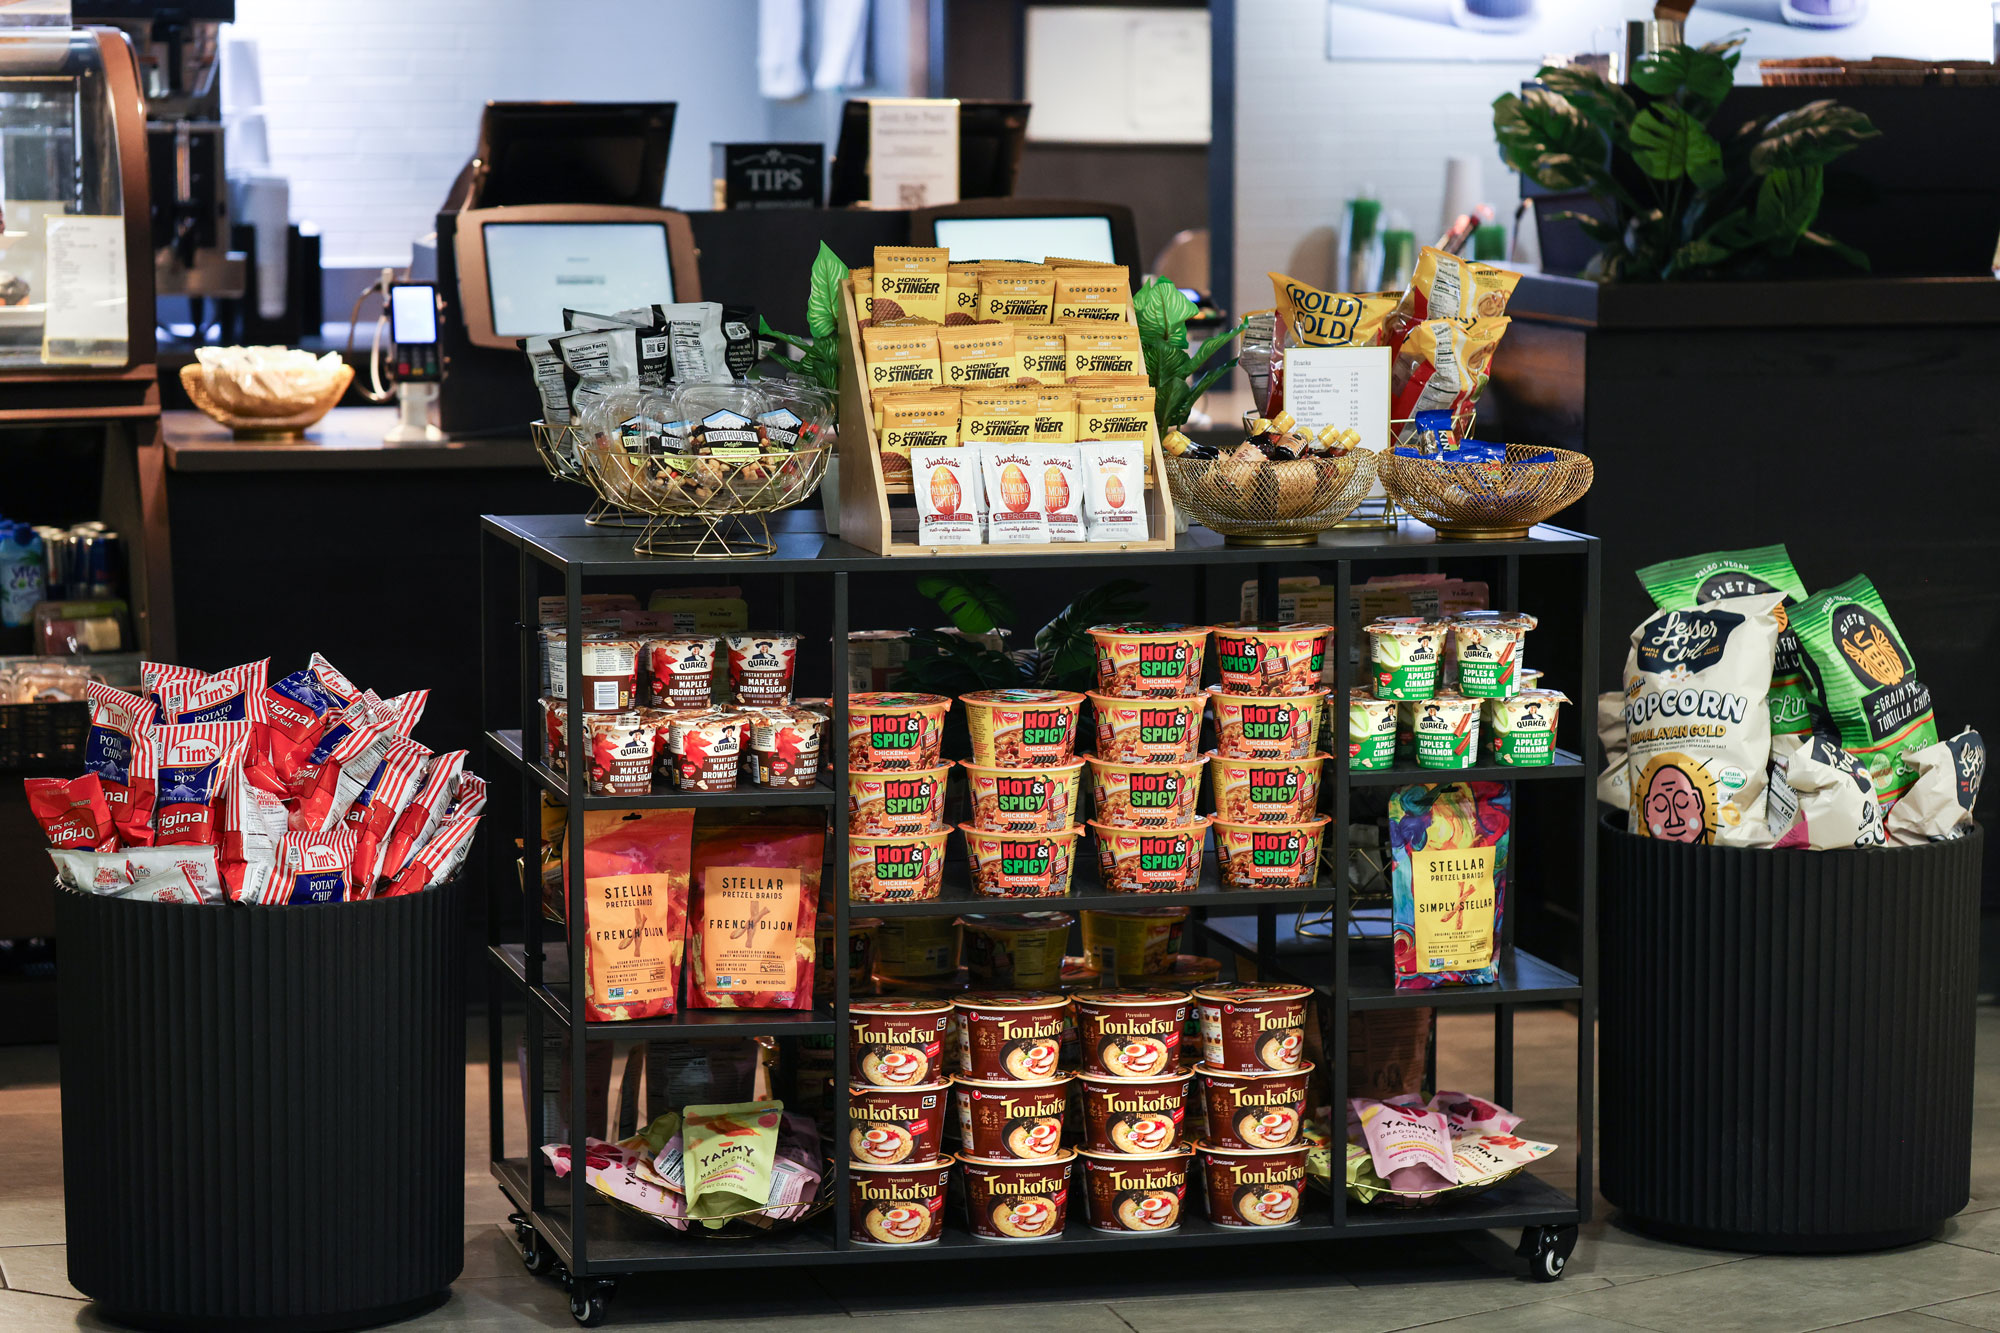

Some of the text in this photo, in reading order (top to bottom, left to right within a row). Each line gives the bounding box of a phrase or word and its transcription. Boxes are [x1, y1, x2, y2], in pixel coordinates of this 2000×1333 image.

[747, 168, 803, 191] TIPS
[894, 282, 940, 294] STINGER
[1002, 304, 1048, 315] STINGER
[1292, 288, 1354, 317] ROLD
[568, 345, 592, 353] Nutrition
[592, 342, 607, 350] Facts
[599, 359, 608, 367] 160
[889, 363, 922, 371] HONEY
[965, 362, 999, 370] HONEY
[1088, 360, 1133, 372] STINGER
[888, 368, 934, 382] STINGER
[964, 366, 1010, 381] STINGER
[983, 424, 1030, 436] STINGER
[1102, 421, 1149, 433] STINGER
[707, 431, 756, 442] NORTHWEST
[924, 456, 961, 469] Justin's
[995, 454, 1031, 467] Justin's
[1098, 455, 1128, 466] Justin's
[1001, 482, 1029, 493] ALMOND
[1002, 492, 1029, 505] BUTTER
[1695, 560, 1749, 579] PALEO VEGAN
[1711, 581, 1756, 600] SIETE
[1652, 611, 1718, 645] Lesser
[1840, 613, 1866, 635] SIETE
[1463, 650, 1493, 659] QUAKER
[1662, 635, 1711, 663] Evil
[748, 659, 780, 668] QUAKER
[1221, 655, 1257, 672] SPICY
[1409, 653, 1435, 663] QUAKER
[679, 661, 708, 671] QUAKER
[1141, 661, 1184, 677] SPICY
[1463, 669, 1488, 677] APPLES
[748, 678, 773, 687] MAPLE
[1223, 672, 1243, 680] CHICKEN
[1407, 672, 1430, 680] APPLES
[1462, 677, 1497, 685] CINNAMON
[679, 680, 702, 689] MAPLE
[739, 685, 787, 693] BROWN SUGAR
[1405, 679, 1435, 688] CINNAMON
[194, 680, 233, 707] Tim's
[669, 686, 712, 696] BROWN SUGAR
[169, 695, 181, 704] 230
[1879, 688, 1906, 712] GRAIN
[194, 704, 232, 723] POTATO
[1625, 688, 1747, 733] POPCORN
[1877, 689, 1931, 733] TORTILLA CHIPS
[105, 706, 129, 733] Tim's
[277, 717, 293, 729] Salt
[1516, 719, 1547, 729] QUAKER
[1024, 728, 1066, 745] SPICY
[1142, 727, 1185, 743] SPICY
[1244, 723, 1289, 739] SPICY
[1630, 724, 1726, 746] HIMALAYAN GOLD
[872, 732, 919, 748] SPICY
[1142, 743, 1171, 751] CHICKEN
[1245, 739, 1273, 747] CHICKEN
[176, 745, 216, 763] Tim's
[1131, 791, 1176, 807] SPICY
[1251, 786, 1297, 802] SPICY
[1780, 805, 1793, 820] 120
[162, 825, 190, 837] Sea Salt
[308, 850, 337, 868] Tim's
[1429, 858, 1485, 873] STELLAR
[722, 877, 784, 891] STELLAR
[1430, 871, 1485, 883] PRETZEL BRAIDS
[604, 884, 653, 899] STELLAR
[722, 891, 783, 900] PRETZEL BRAIDS
[605, 898, 652, 909] PRETZEL BRAIDS
[1419, 898, 1493, 913] SIMPLY STELLAR
[709, 919, 793, 931] FRENCH DIJON
[596, 926, 663, 942] FRENCH DIJON
[1032, 1014, 1053, 1022] Premium
[1095, 1015, 1174, 1035] Tonkotsu
[854, 1023, 935, 1045] Tonkotsu
[1103, 1092, 1181, 1113] Tonkotsu
[1230, 1086, 1304, 1108] Tonkotsu
[1382, 1120, 1437, 1134] YAMMY
[700, 1145, 755, 1167] YAMMY
[700, 1161, 728, 1180] MANGO
[1230, 1164, 1304, 1186] Tonkotsu
[1110, 1170, 1185, 1192] Tonkotsu
